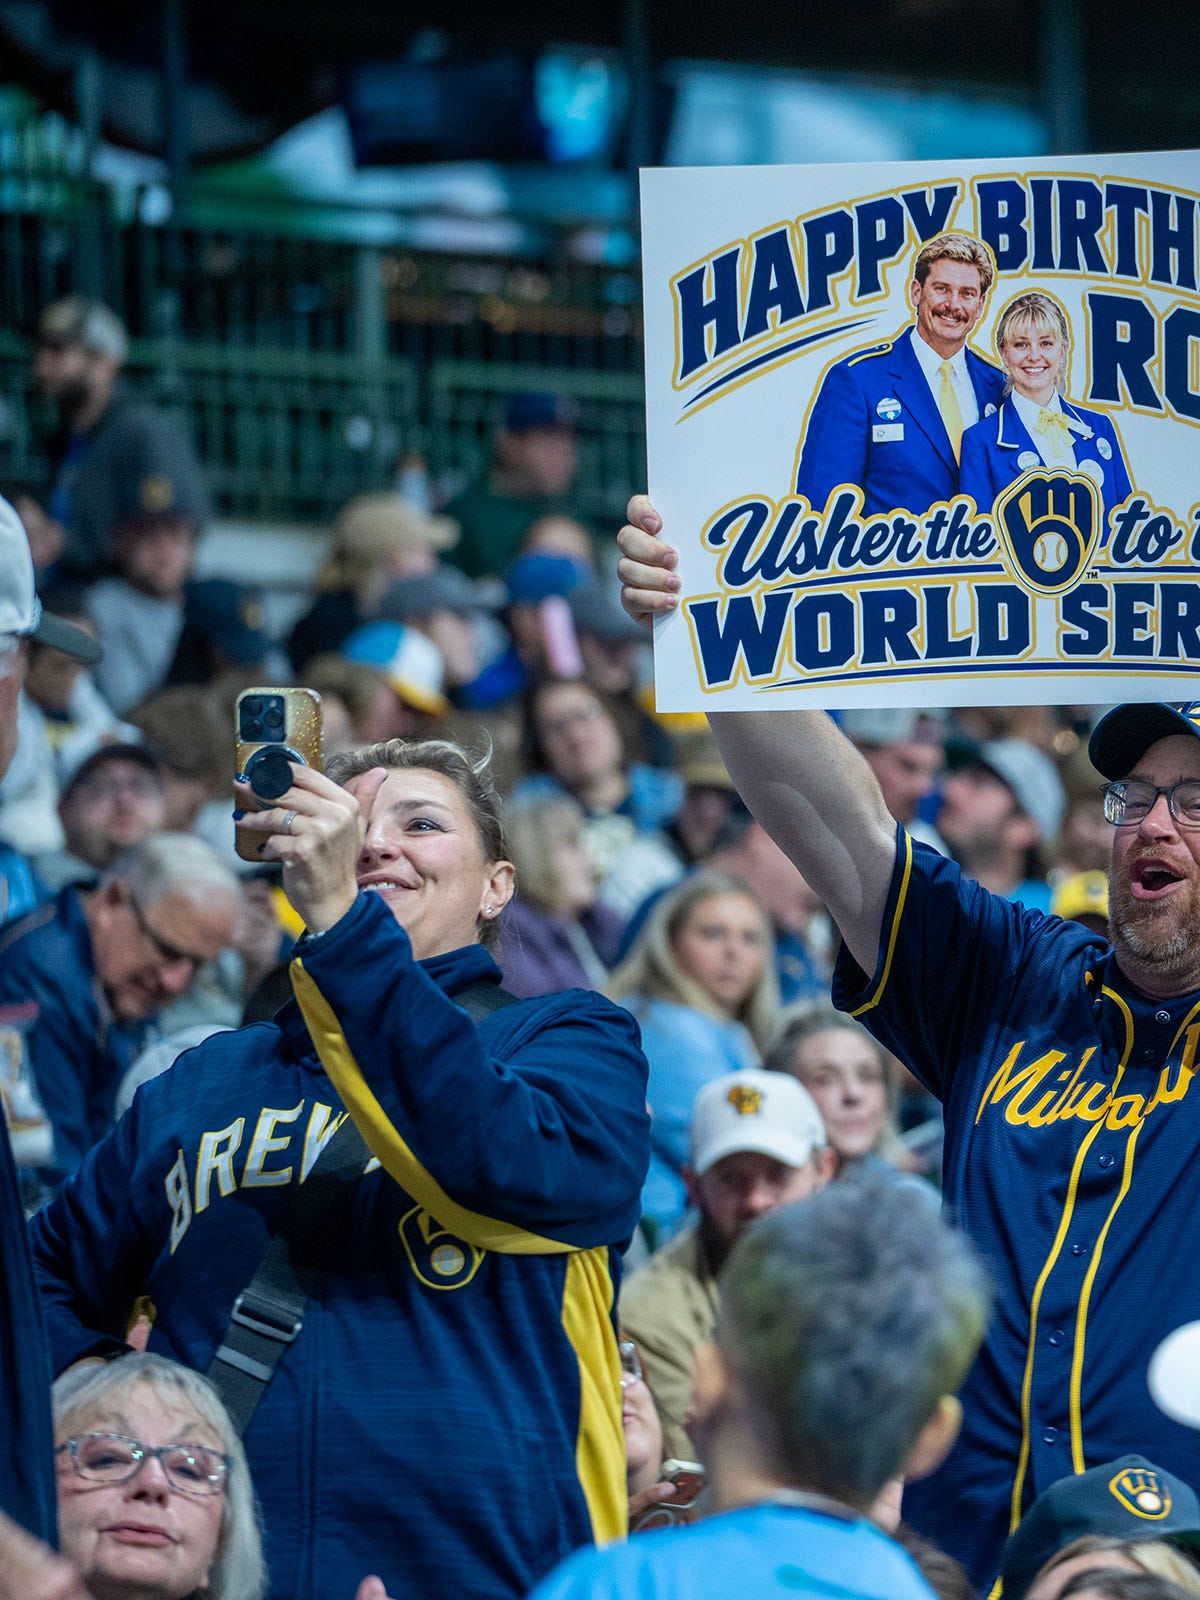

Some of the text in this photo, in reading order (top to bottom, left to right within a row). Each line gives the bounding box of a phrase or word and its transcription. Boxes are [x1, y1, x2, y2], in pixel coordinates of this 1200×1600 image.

[676, 183, 960, 382] HAPPY
[708, 490, 922, 584] Usher
[925, 500, 1000, 561] the
[1111, 507, 1180, 556] to
[687, 585, 1032, 686] WORLD
